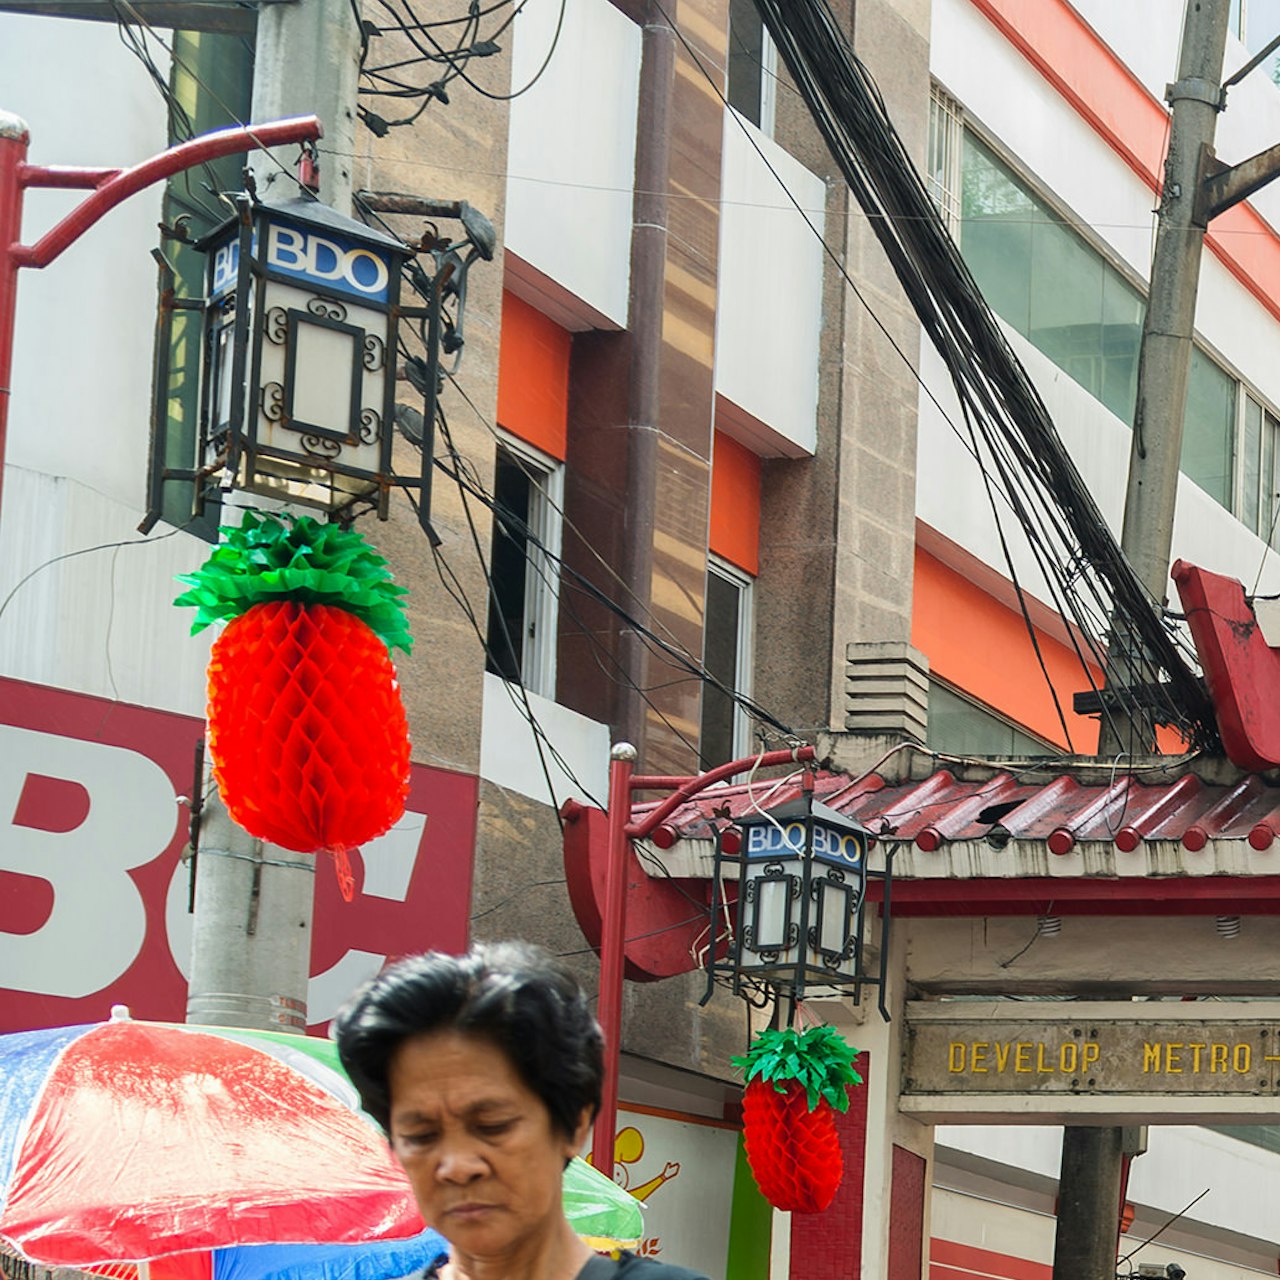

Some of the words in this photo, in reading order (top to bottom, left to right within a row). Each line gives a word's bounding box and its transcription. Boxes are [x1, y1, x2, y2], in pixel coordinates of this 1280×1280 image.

[267, 224, 389, 294] BDO
[748, 822, 807, 852] BDO
[812, 825, 862, 863] BDO
[948, 1042, 1100, 1073] DEVELOP
